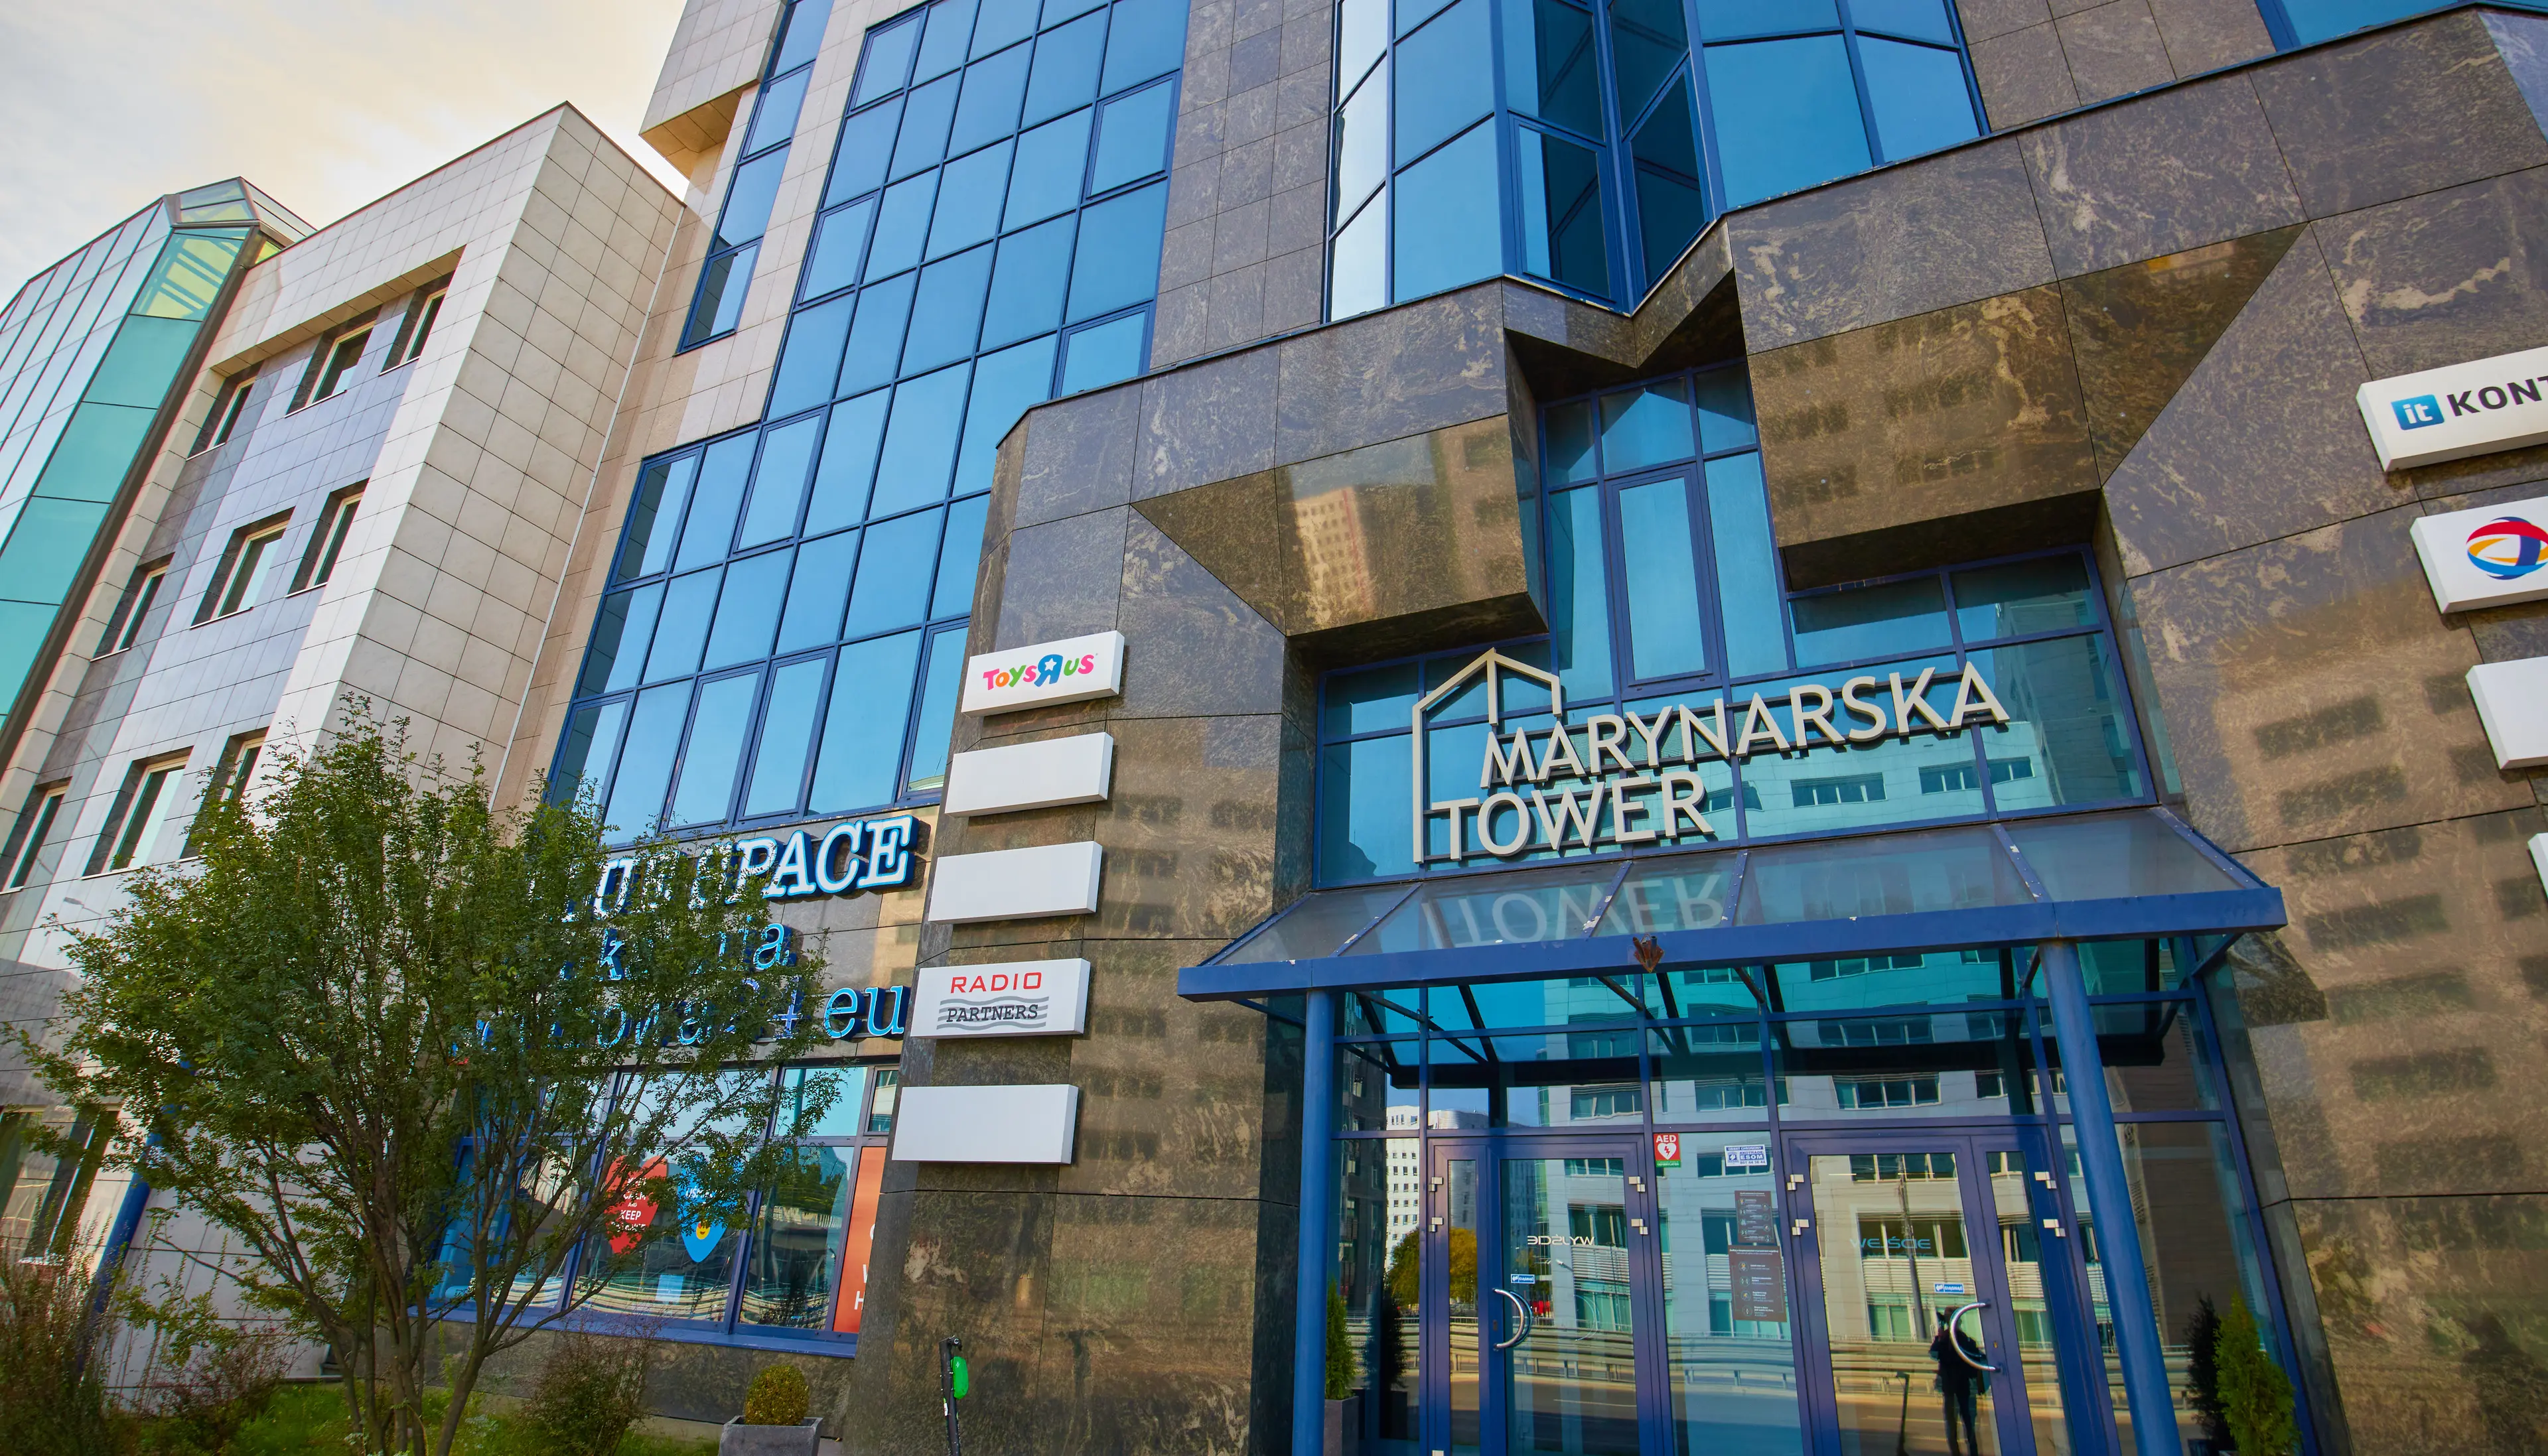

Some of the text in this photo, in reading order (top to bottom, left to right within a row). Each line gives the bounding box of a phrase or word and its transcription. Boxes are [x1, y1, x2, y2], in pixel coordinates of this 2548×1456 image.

[1480, 661, 2011, 789] MARYNARSKA
[1431, 771, 1715, 862] TOWER
[950, 972, 1042, 994] RADIO
[946, 1004, 1039, 1022] PARTNERS
[618, 1209, 642, 1221] KEEP
